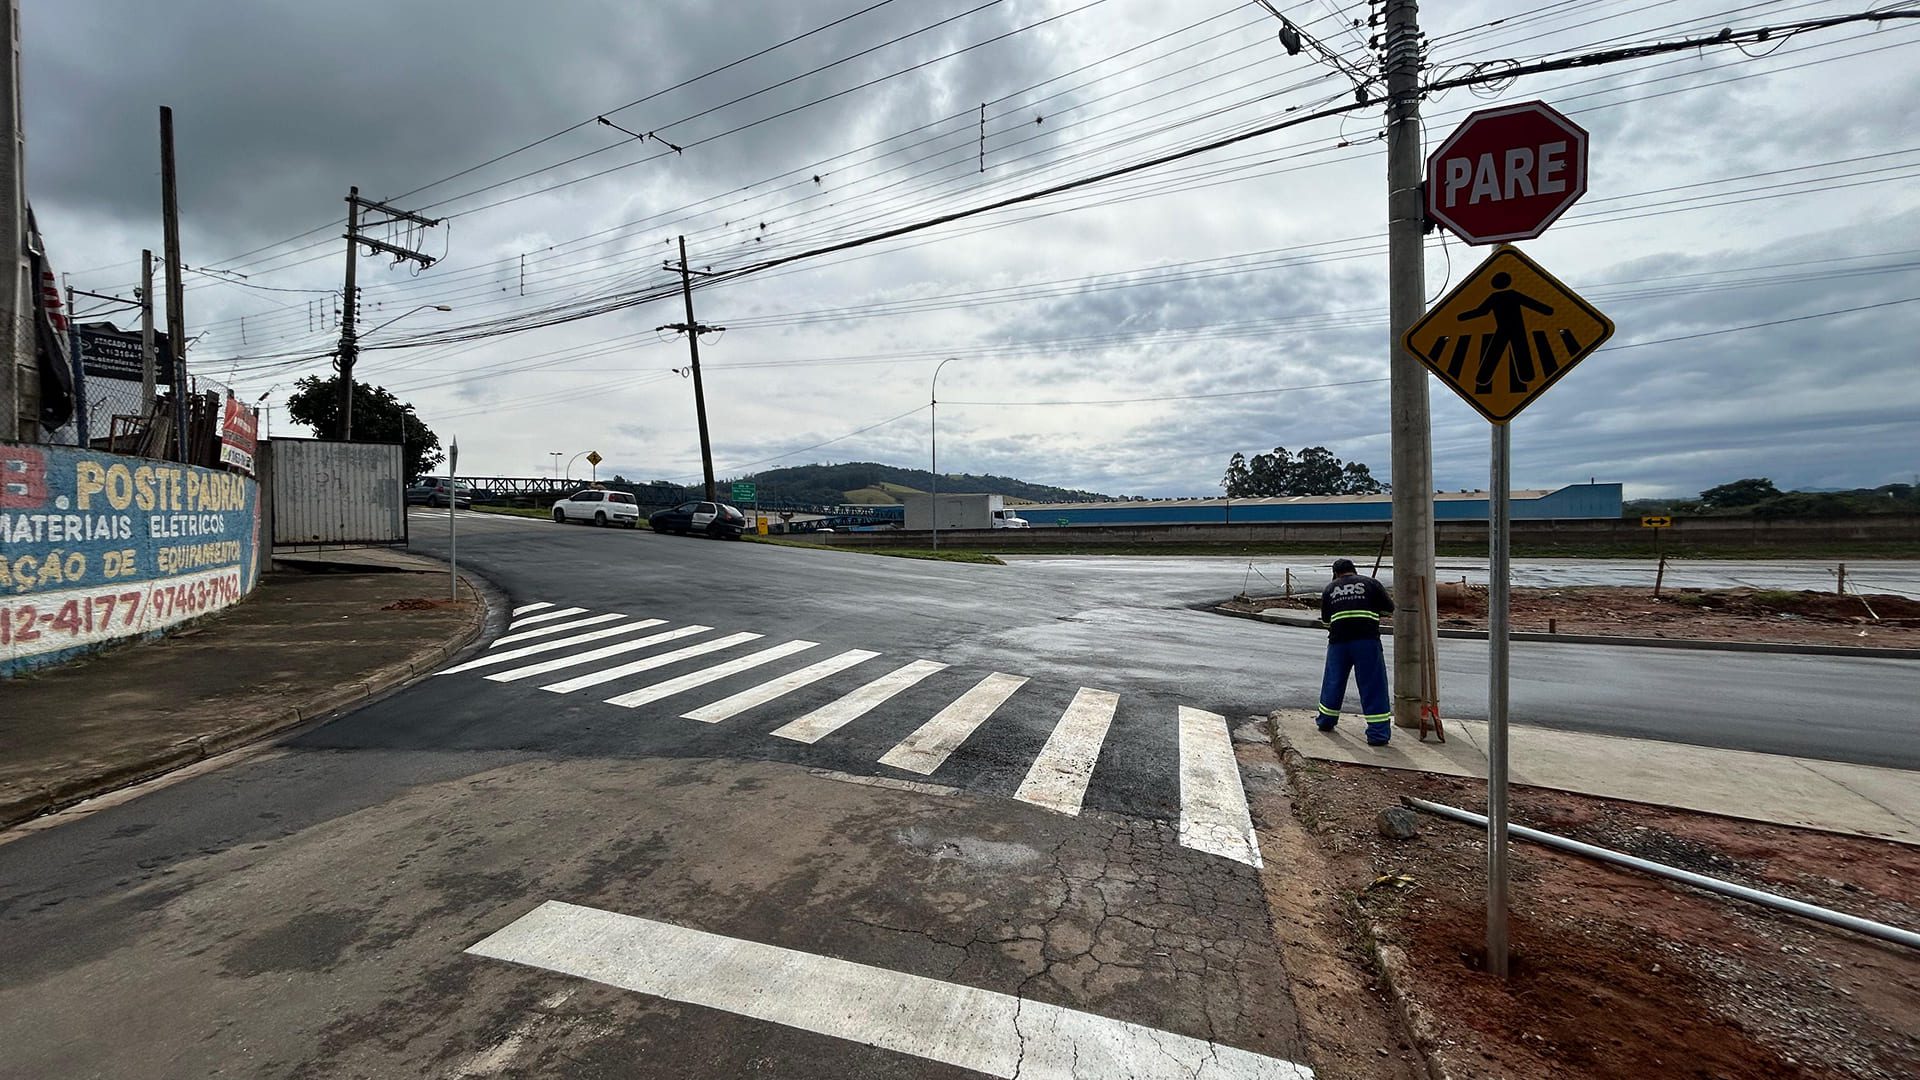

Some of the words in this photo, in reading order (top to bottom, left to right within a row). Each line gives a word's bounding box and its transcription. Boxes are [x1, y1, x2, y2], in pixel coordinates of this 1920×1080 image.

[1445, 140, 1567, 208] PARE
[77, 461, 182, 511] POSTE
[150, 511, 225, 538] ELÉTRICOS
[103, 549, 137, 578] DE
[1330, 582, 1365, 599] ARS
